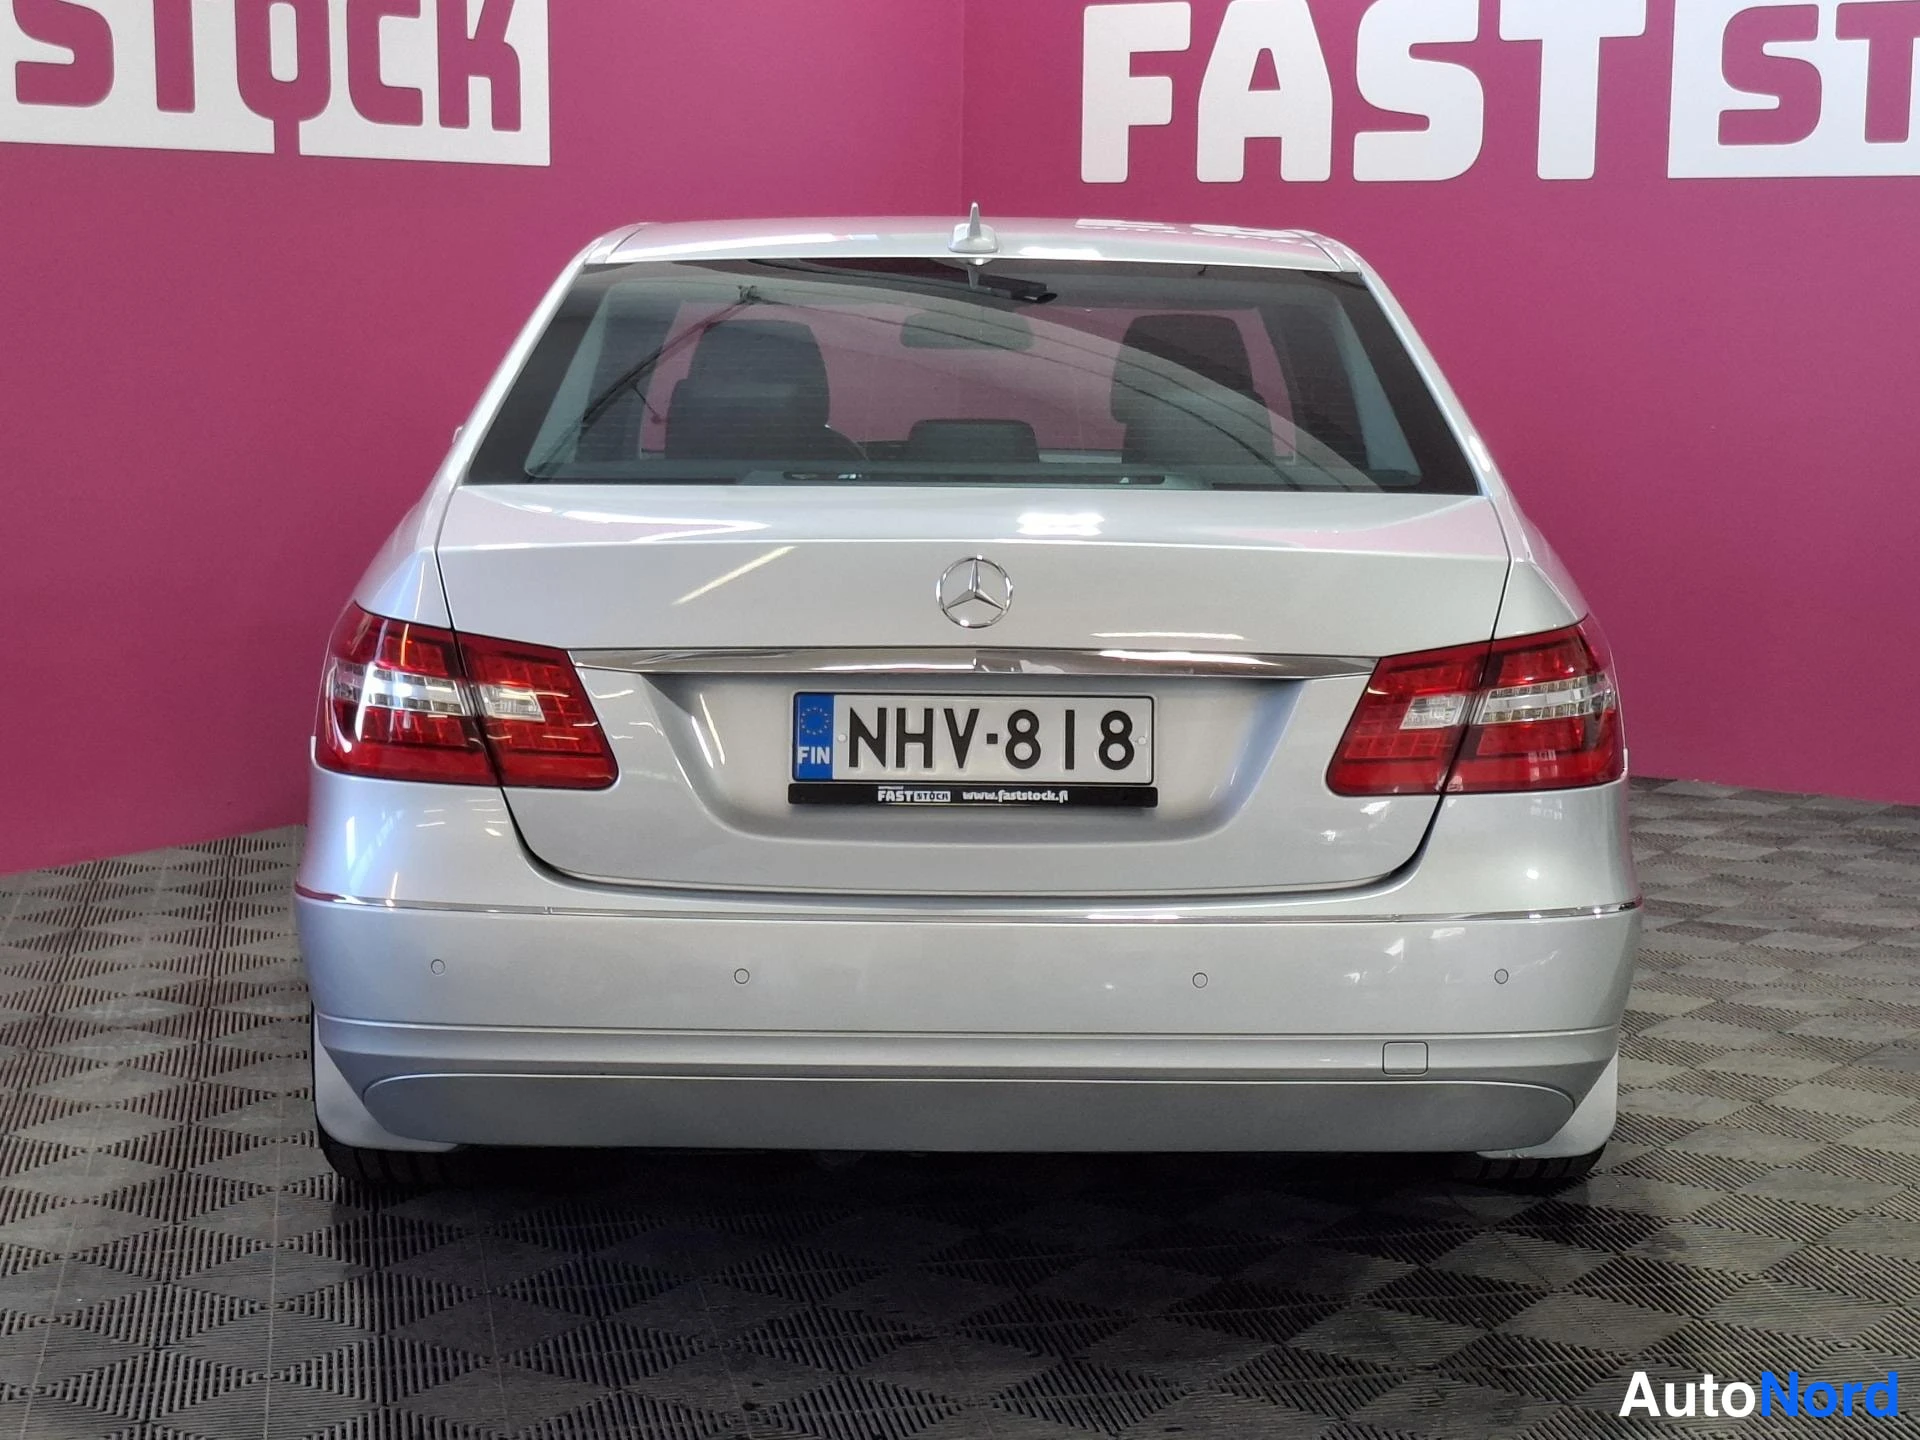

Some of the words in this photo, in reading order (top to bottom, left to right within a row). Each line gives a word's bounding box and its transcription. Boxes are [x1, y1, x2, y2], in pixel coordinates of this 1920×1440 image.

[13, 0, 522, 132] STOCK
[798, 746, 831, 765] FIN
[848, 707, 1136, 771] NHV-818
[962, 789, 1069, 803] www.faststock.fi
